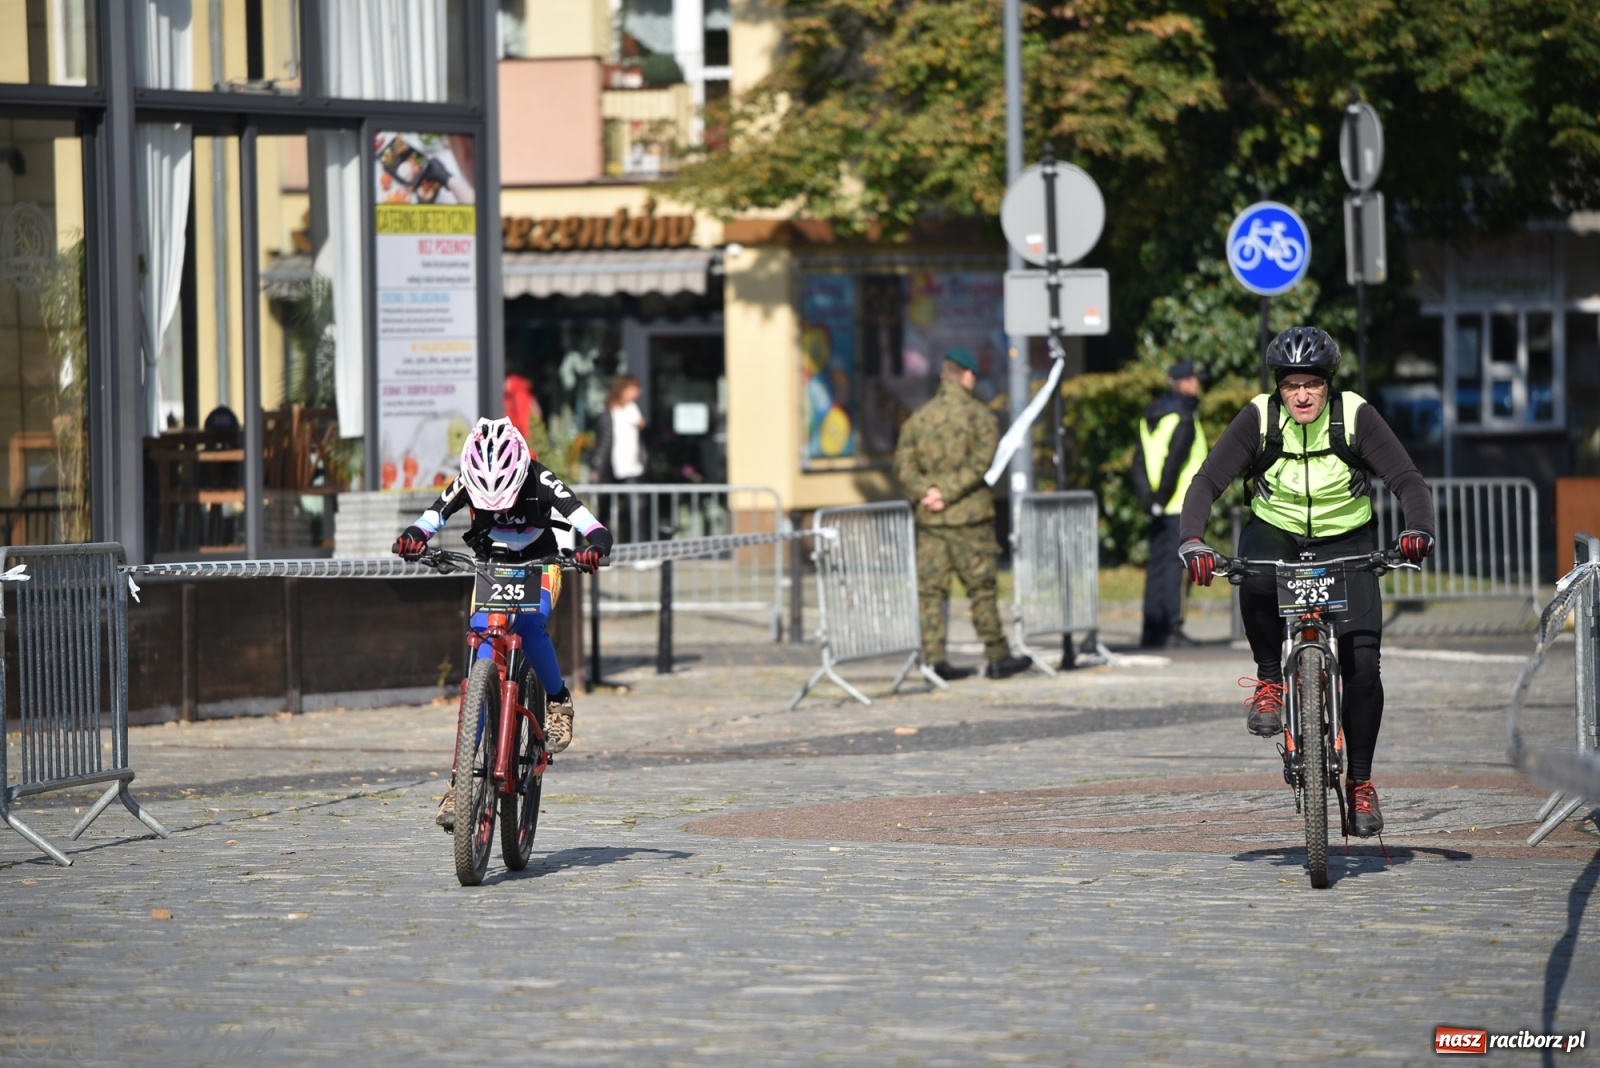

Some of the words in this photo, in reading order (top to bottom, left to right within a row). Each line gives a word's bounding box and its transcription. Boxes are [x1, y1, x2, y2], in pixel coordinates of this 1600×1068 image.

[503, 197, 695, 249] ezentów
[491, 583, 525, 600] 235
[1295, 586, 1329, 604] 235
